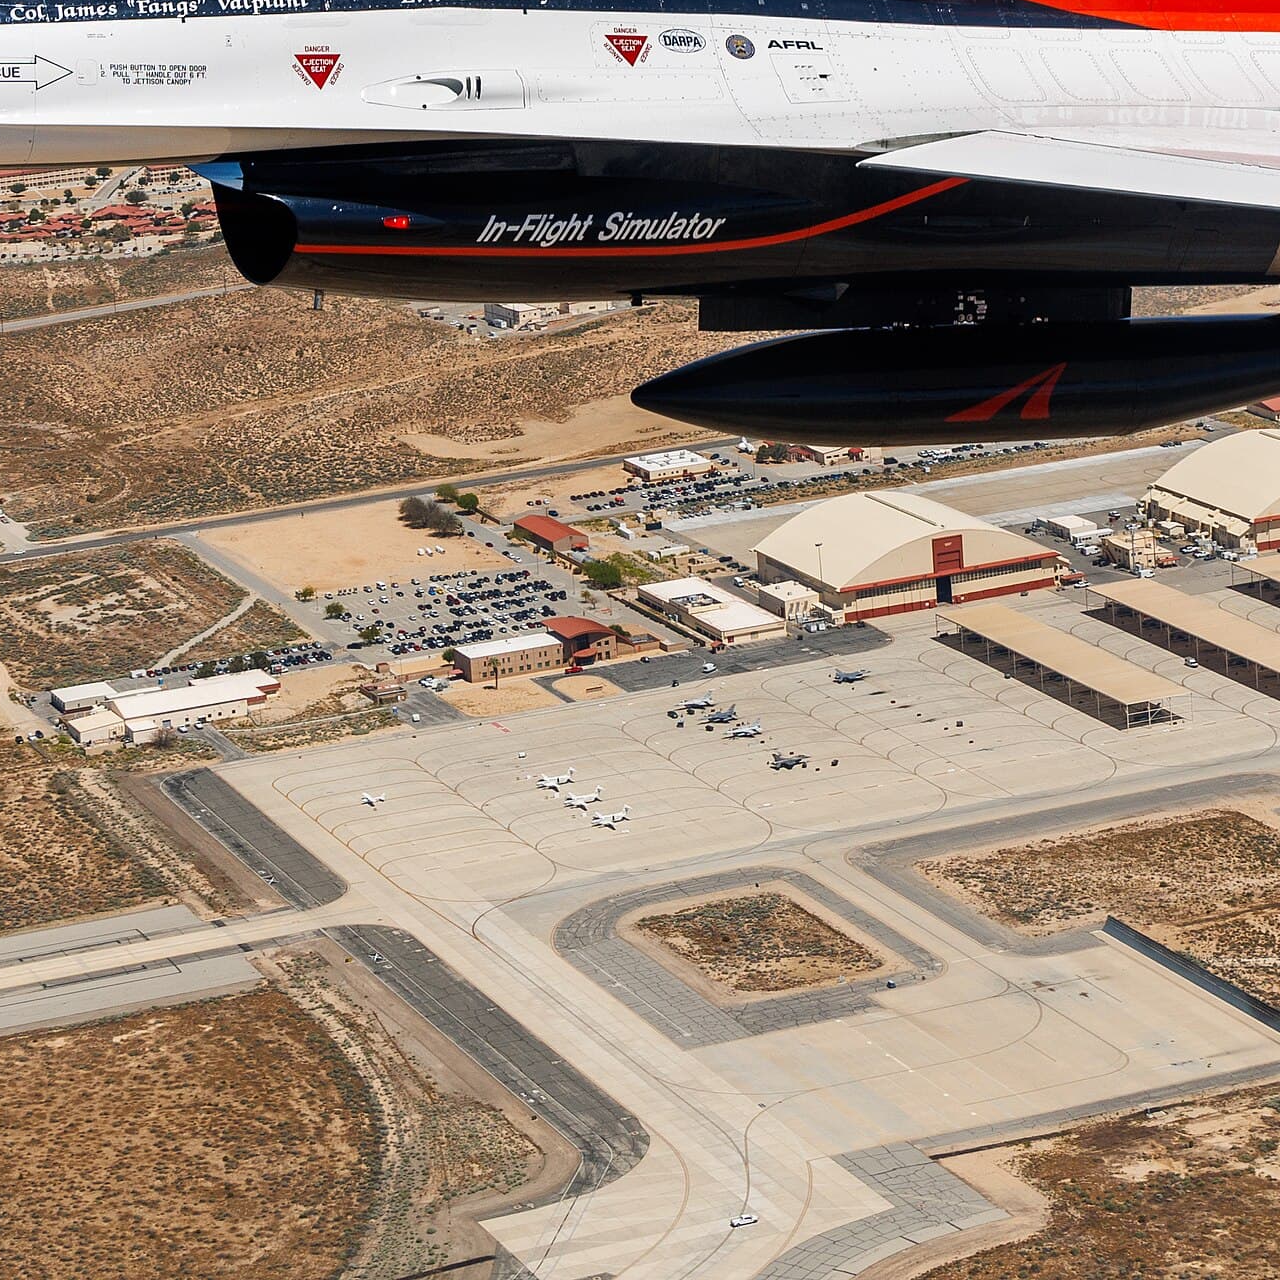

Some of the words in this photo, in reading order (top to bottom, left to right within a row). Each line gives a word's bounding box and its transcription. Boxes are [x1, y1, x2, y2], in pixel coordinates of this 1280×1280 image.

[54, 3, 118, 21] James
[612, 38, 643, 46] EJECTION
[662, 34, 703, 48] DARPA
[767, 39, 824, 51] AFRL
[304, 45, 330, 53] DANGER
[302, 58, 334, 66] EJECTION
[158, 64, 167, 72] TO
[168, 64, 187, 72] OPEN
[189, 65, 208, 73] DOOR
[310, 65, 327, 73] SEAT
[146, 71, 172, 79] HANDLE
[174, 71, 187, 79] OUT
[122, 77, 131, 85] TO
[133, 77, 164, 86] JETTISON
[166, 78, 192, 86] CANOPY
[476, 212, 595, 248] In-Flight
[597, 210, 727, 242] Simulator
